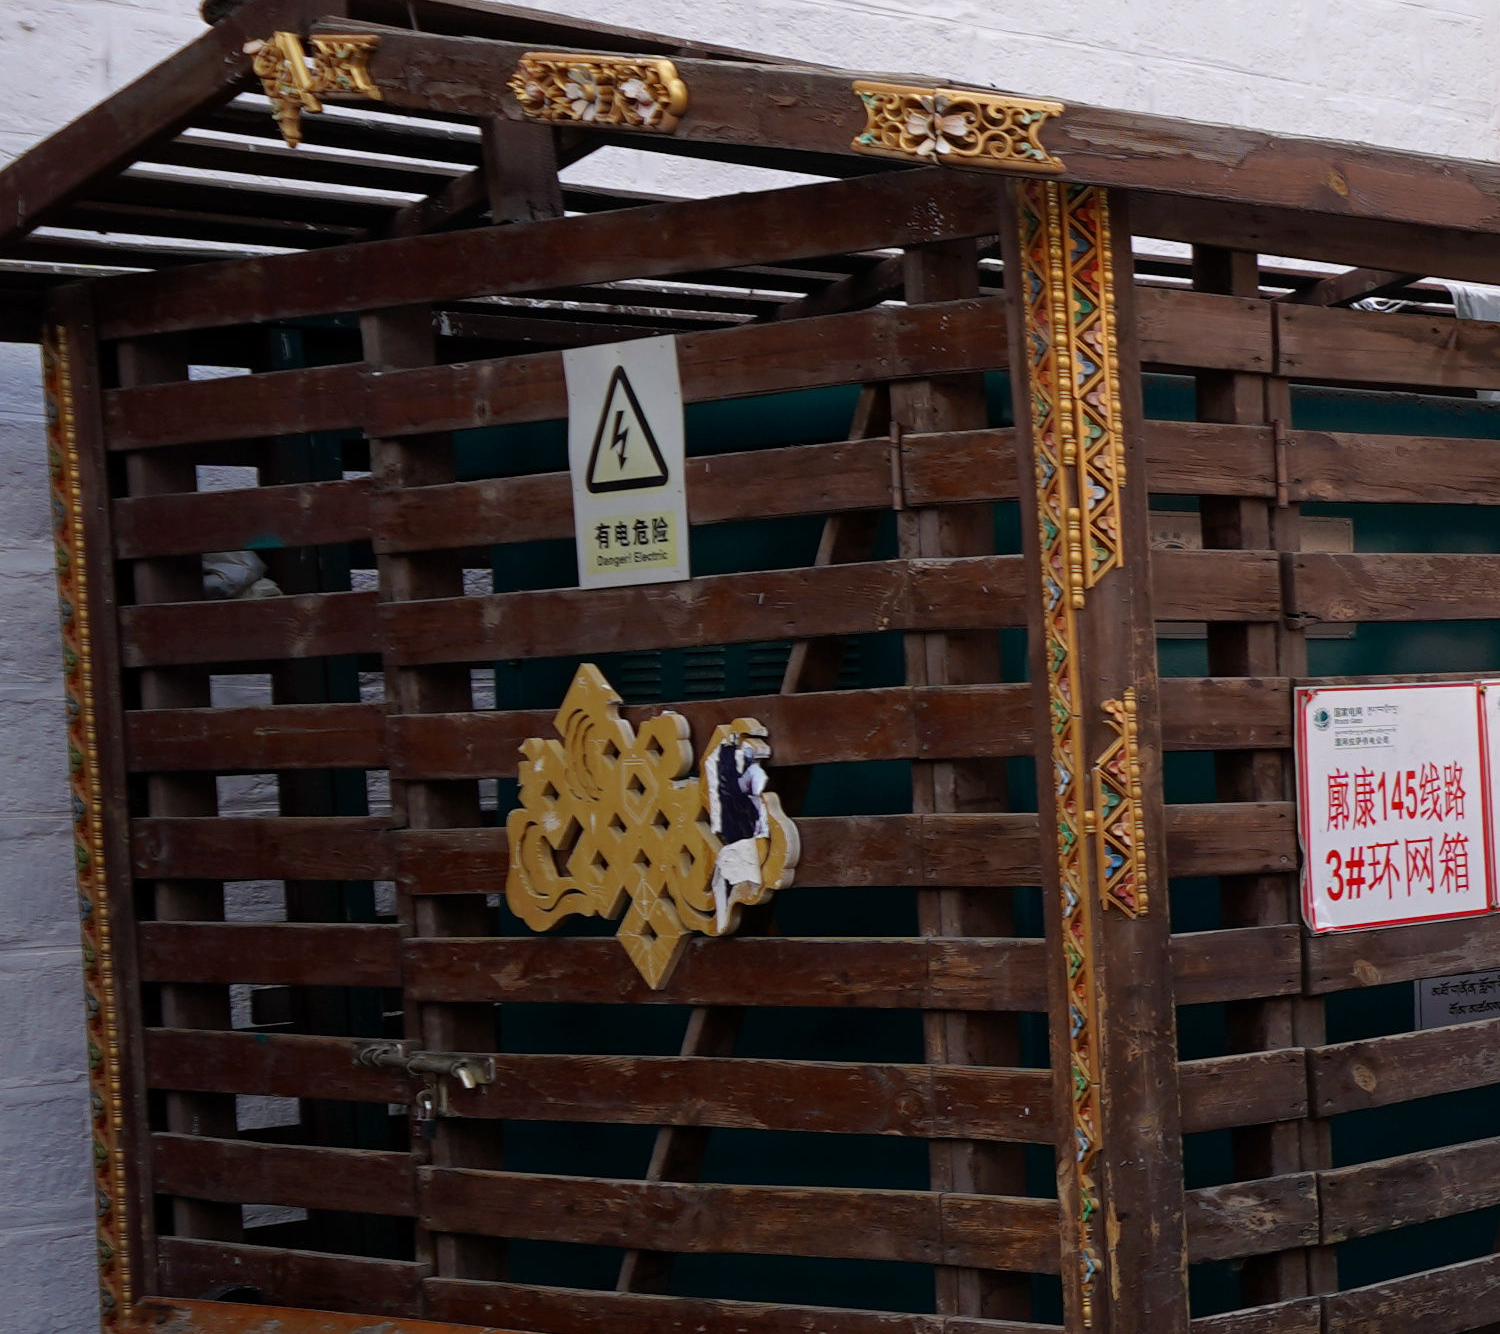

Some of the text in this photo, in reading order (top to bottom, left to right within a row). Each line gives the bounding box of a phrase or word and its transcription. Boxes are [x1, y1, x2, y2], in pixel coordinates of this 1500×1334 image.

[594, 515, 670, 549] 有电危险
[596, 550, 668, 567] Danger! Electric
[1326, 760, 1467, 833] 廓康145线路
[1325, 831, 1470, 902] 3#环网箱
